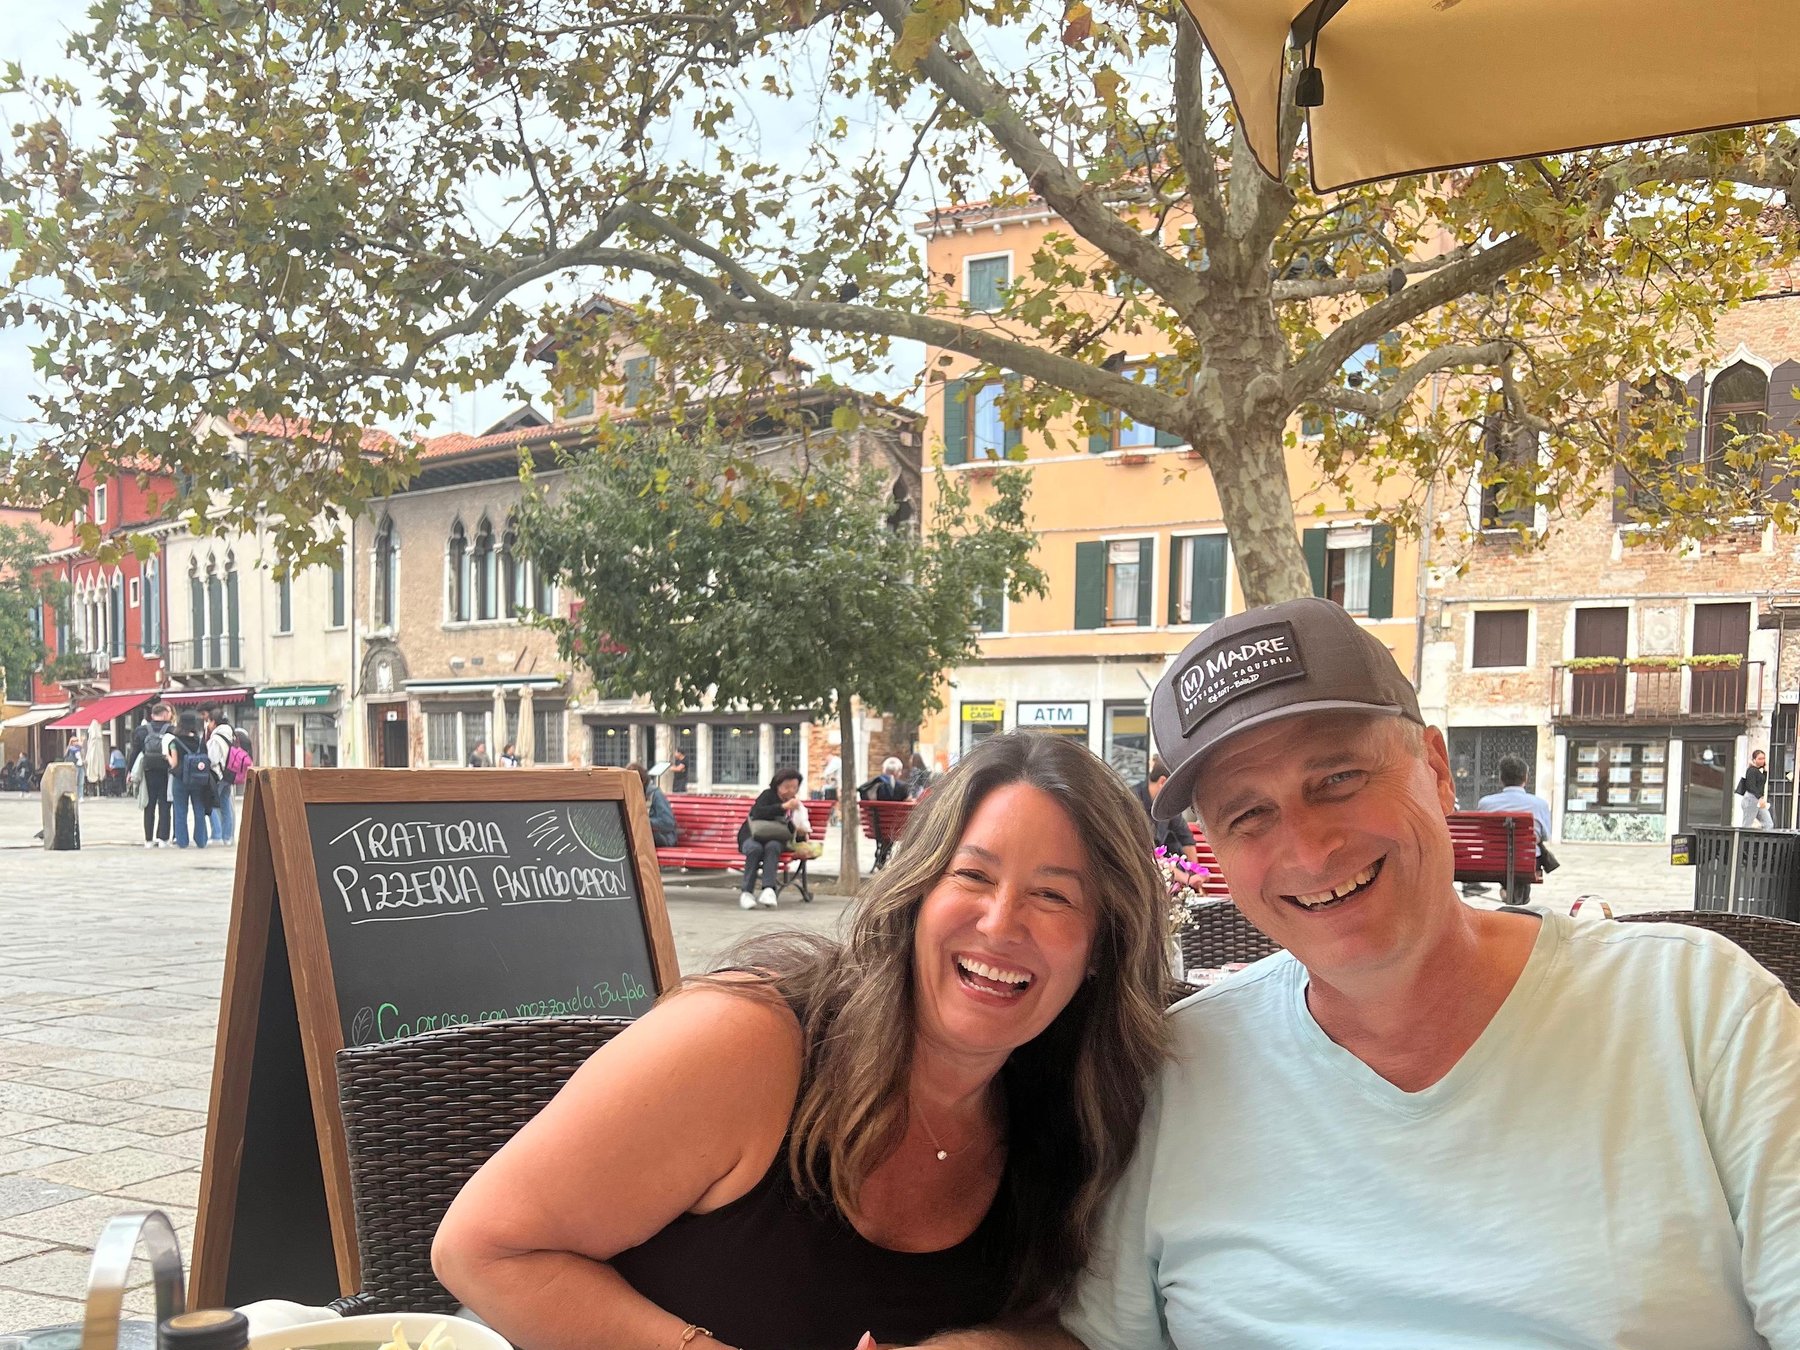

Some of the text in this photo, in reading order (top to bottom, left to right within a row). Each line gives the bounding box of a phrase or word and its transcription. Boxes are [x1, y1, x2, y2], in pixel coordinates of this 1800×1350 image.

[1205, 636, 1289, 678] MADRE
[1233, 656, 1293, 678] TAQUERIA
[969, 711, 995, 720] CASH
[1034, 707, 1073, 721] ATM
[329, 817, 508, 861] TRATTORIA
[333, 865, 485, 913] PIZZERIA
